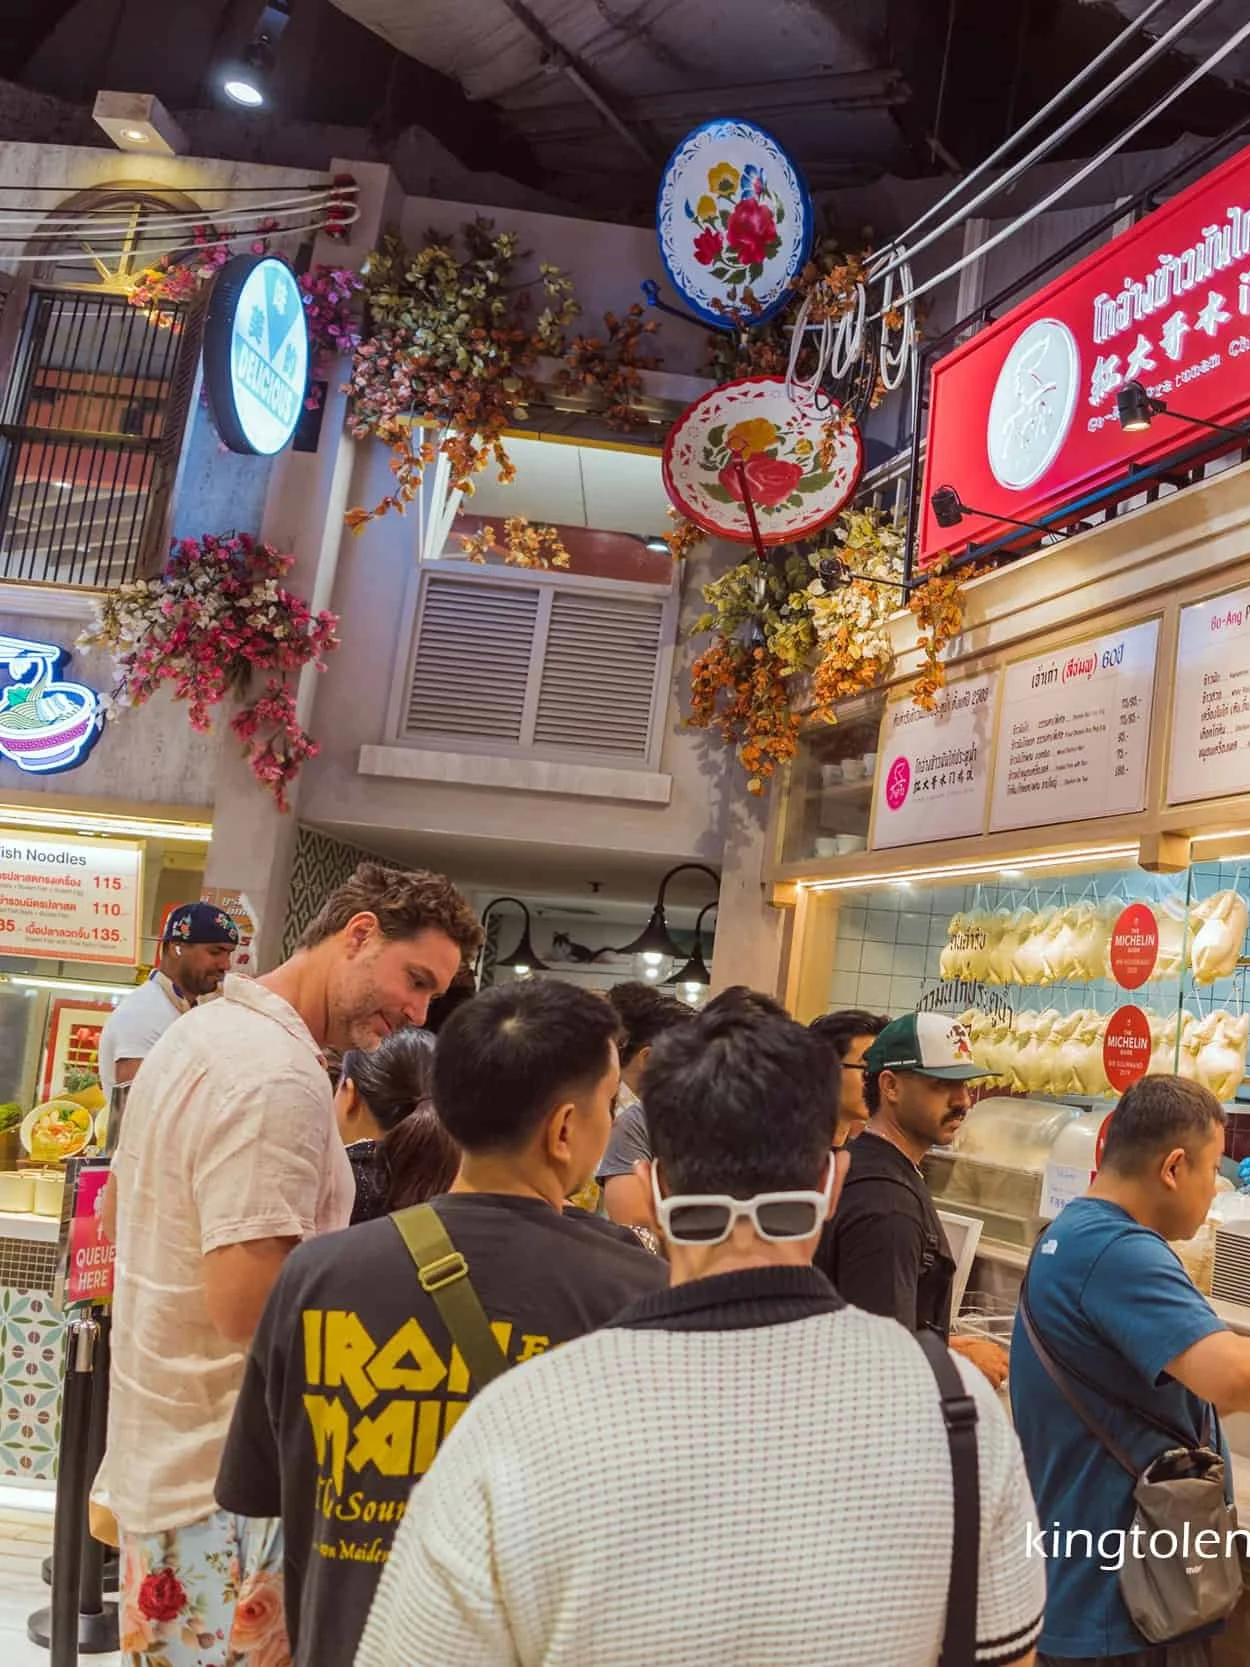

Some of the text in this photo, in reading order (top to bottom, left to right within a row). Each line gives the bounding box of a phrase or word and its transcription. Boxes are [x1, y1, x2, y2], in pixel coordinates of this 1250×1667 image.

[237, 342, 292, 424] DELICIOUS
[1210, 609, 1243, 631] Go-Ang
[26, 849, 87, 866] Noodles
[1115, 935, 1155, 946] MICHELIN
[1107, 1036, 1148, 1049] MICHELIN
[76, 1246, 116, 1267] QUEUE
[78, 1269, 109, 1291] HERE
